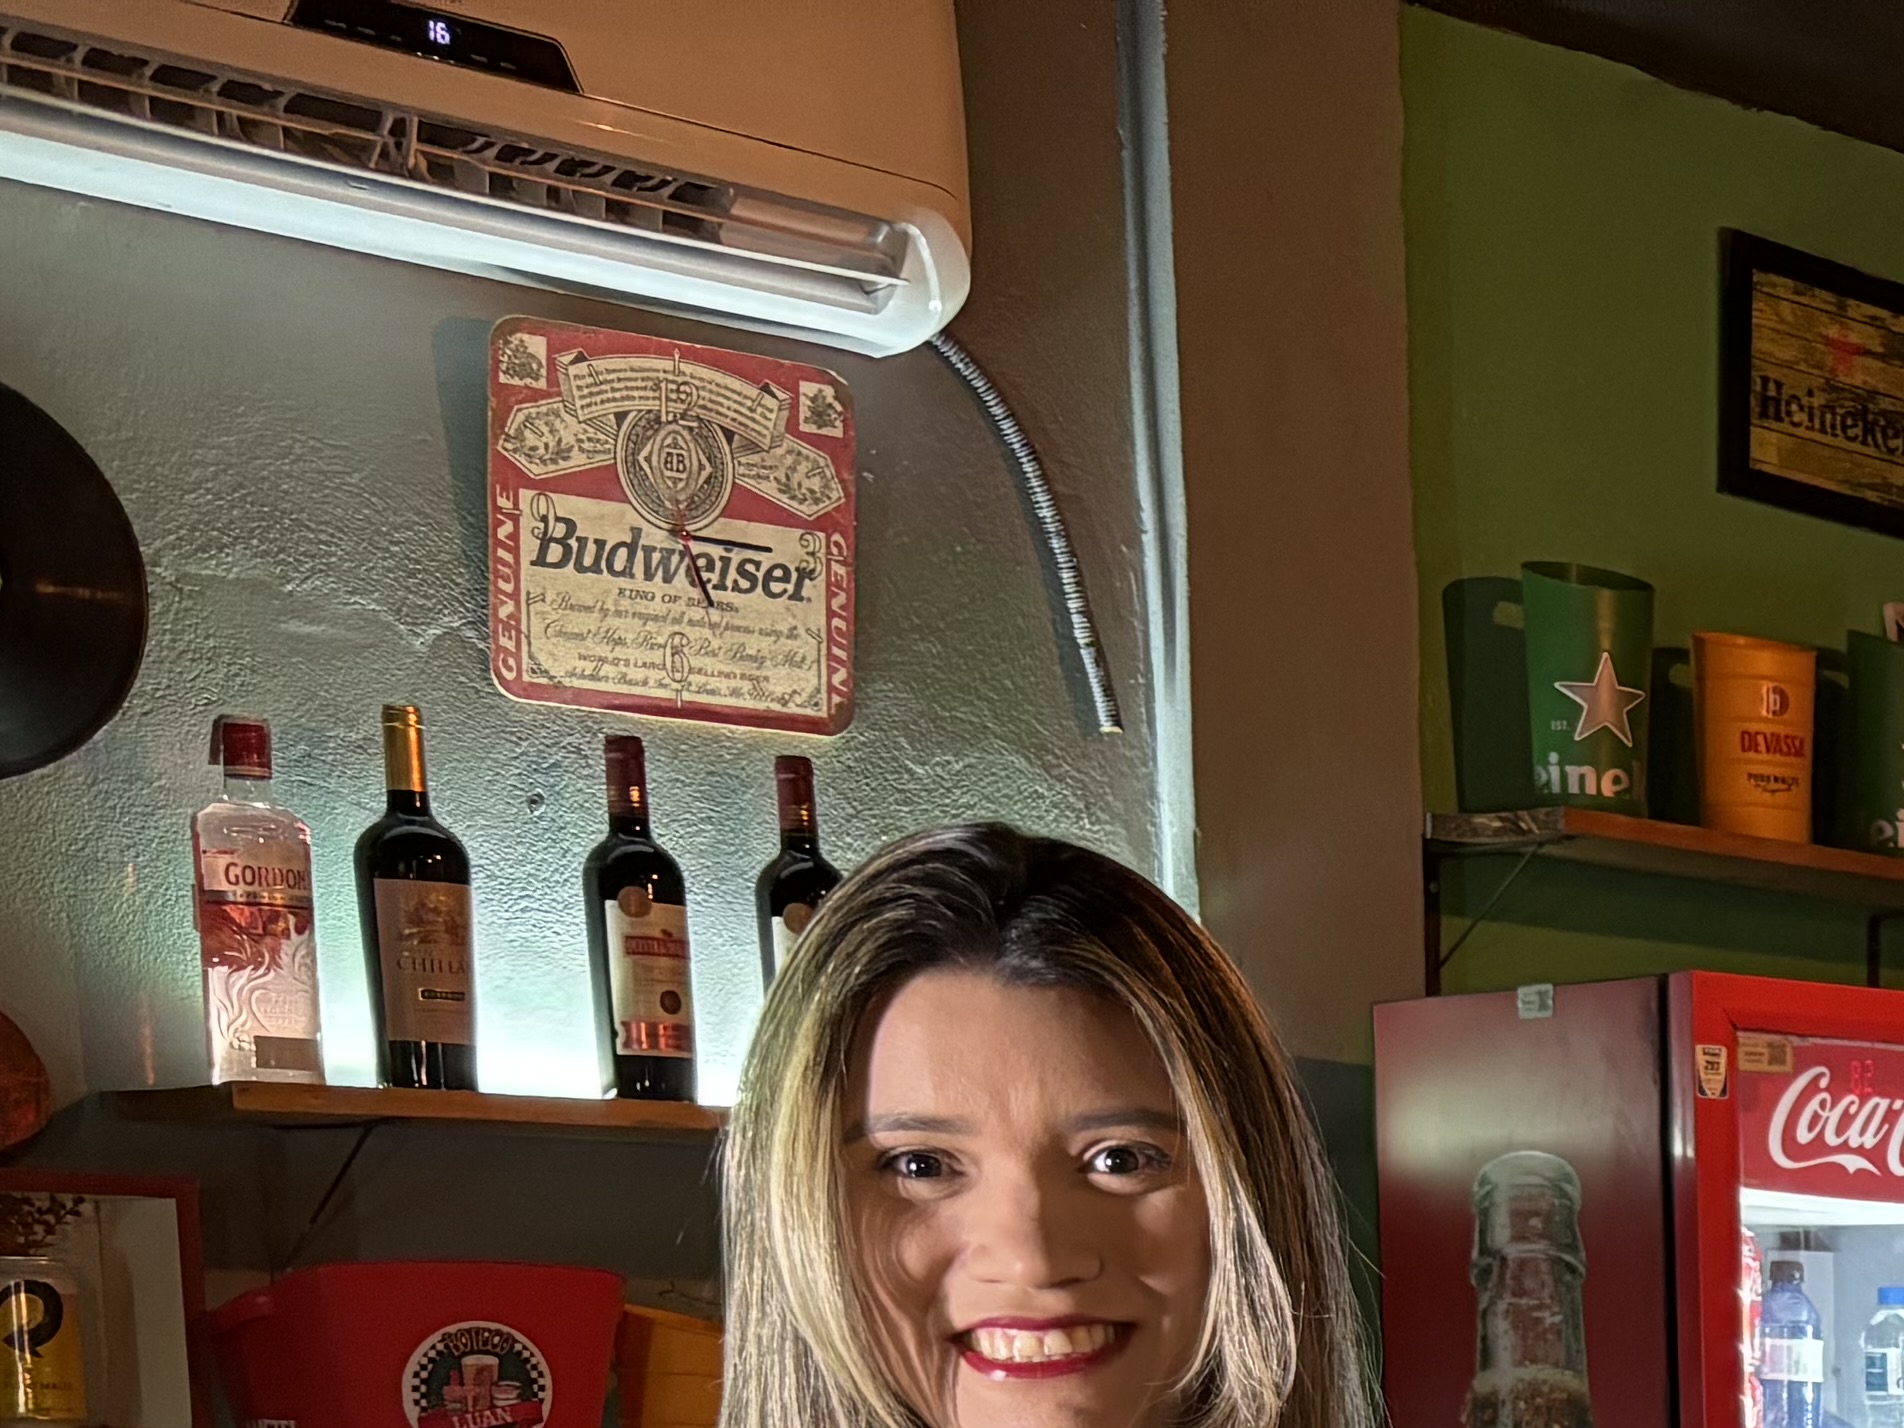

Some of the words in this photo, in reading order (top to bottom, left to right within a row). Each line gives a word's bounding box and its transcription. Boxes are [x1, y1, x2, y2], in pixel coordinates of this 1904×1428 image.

[428, 20, 450, 45] 16
[494, 485, 518, 681] GENUINE
[529, 512, 814, 604] Budweiser
[617, 587, 656, 602] KING
[661, 593, 682, 605] OF
[687, 596, 735, 613] BERS
